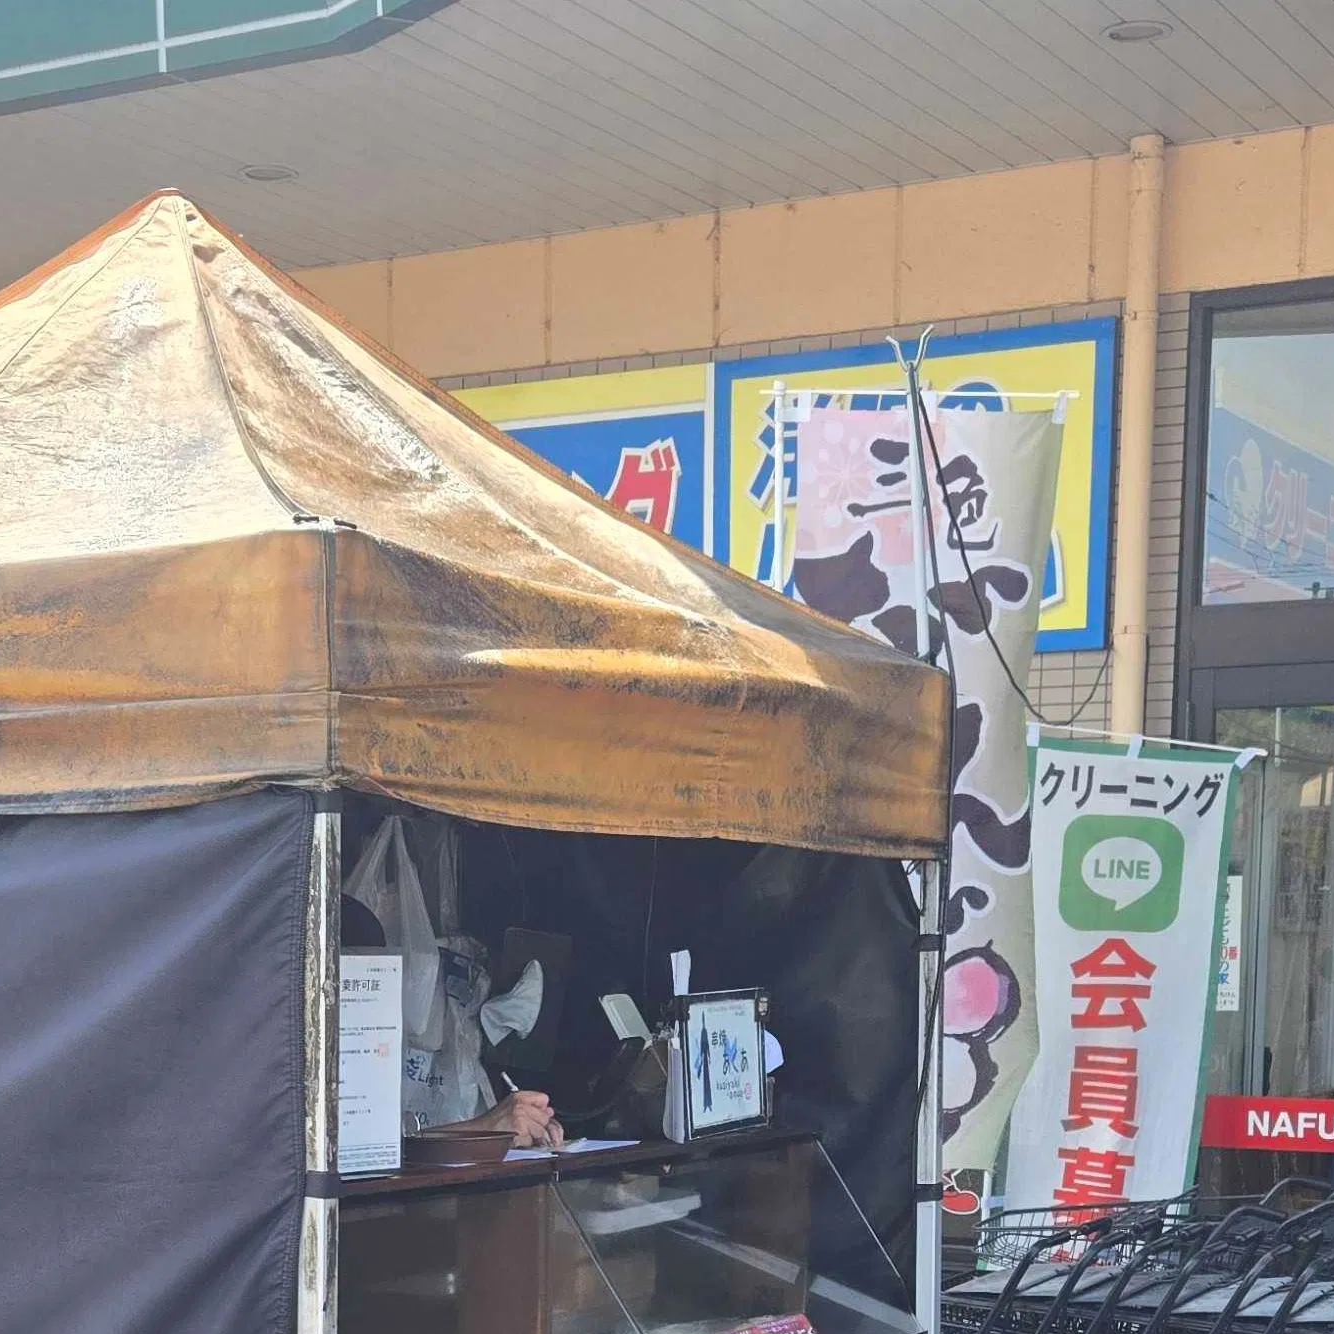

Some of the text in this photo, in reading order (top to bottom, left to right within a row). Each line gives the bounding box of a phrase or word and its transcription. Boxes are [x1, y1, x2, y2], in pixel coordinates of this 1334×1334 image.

[1039, 762, 1224, 817] クリーニング
[1094, 859, 1150, 881] LINE
[418, 1071, 444, 1088] Light
[1053, 938, 1157, 1267] 会員募
